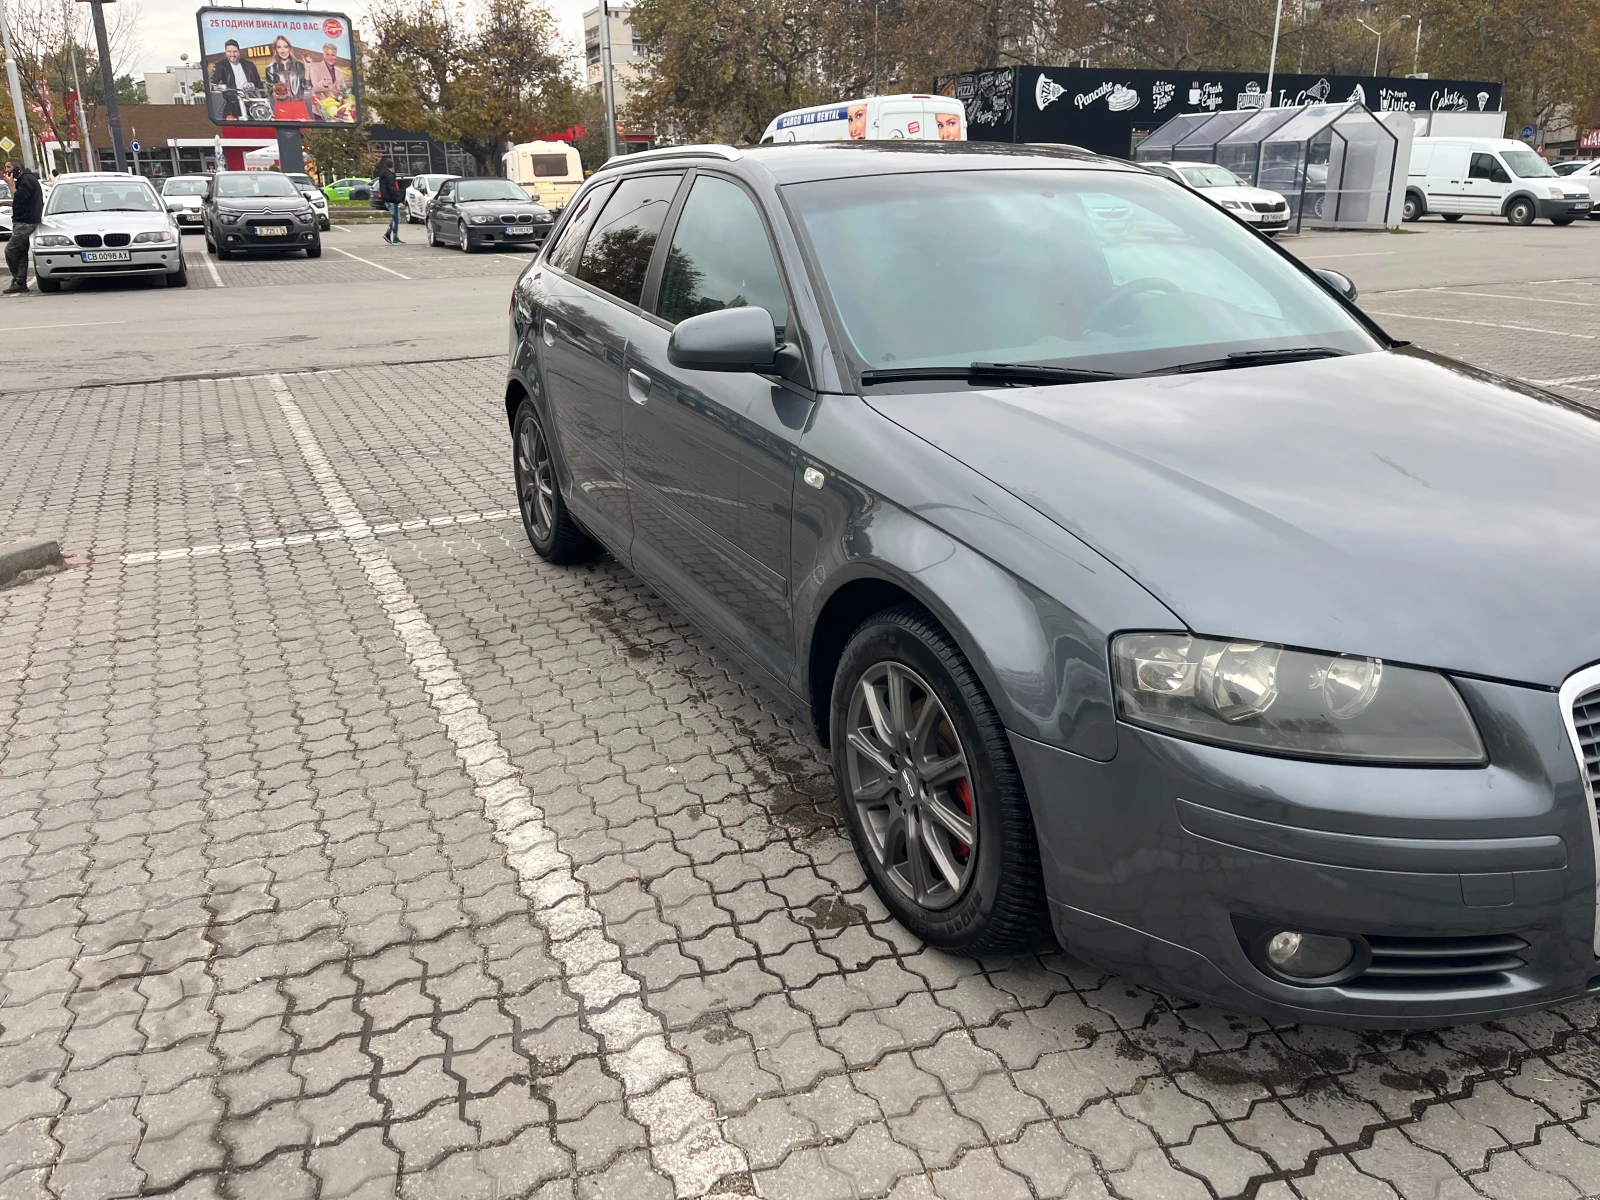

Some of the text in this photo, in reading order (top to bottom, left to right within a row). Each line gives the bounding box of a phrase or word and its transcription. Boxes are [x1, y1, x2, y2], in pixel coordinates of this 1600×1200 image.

[209, 19, 219, 28] 25
[220, 19, 254, 29] ГОДИНИ
[256, 20, 288, 30] ВИНАГИ
[289, 22, 302, 31] ДО
[303, 22, 319, 31] ВАС
[247, 45, 271, 58] BILLA
[957, 84, 975, 97] PIZZA
[1203, 82, 1223, 95] Fresh
[1394, 90, 1408, 98] Fresh
[1074, 81, 1113, 110] Pancake
[1430, 87, 1460, 111] Cakes
[1202, 94, 1223, 111] Coffee
[1389, 98, 1416, 111] Juice
[782, 110, 840, 128] CARGO VAN RENTAL
[87, 253, 98, 261] CB
[98, 252, 117, 260] 0098
